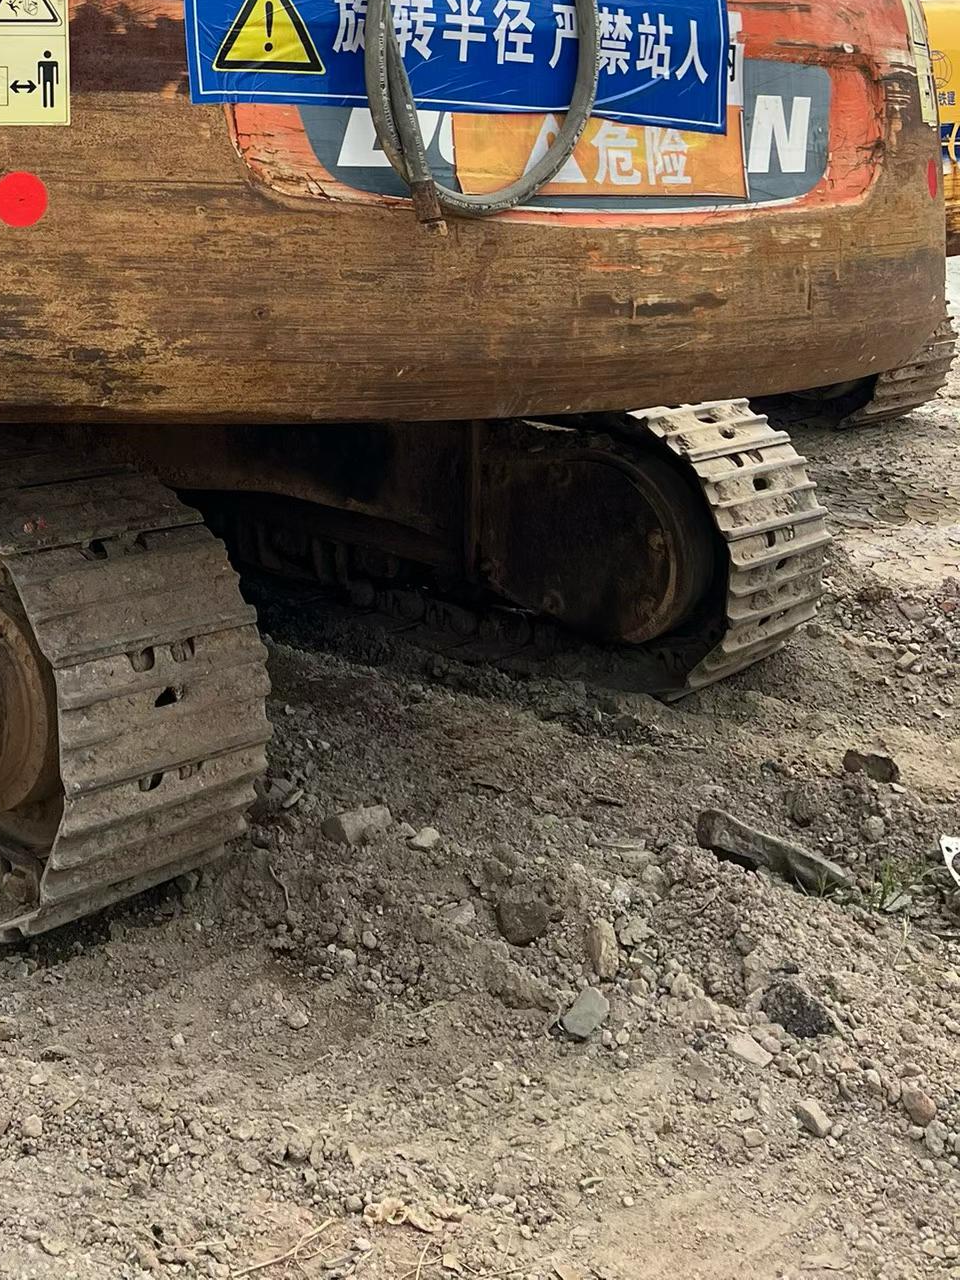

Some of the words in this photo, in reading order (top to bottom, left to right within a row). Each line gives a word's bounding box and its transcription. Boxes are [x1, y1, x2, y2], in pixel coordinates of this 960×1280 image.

[549, 4, 709, 84] 严禁站人
[590, 121, 692, 186] 危险
